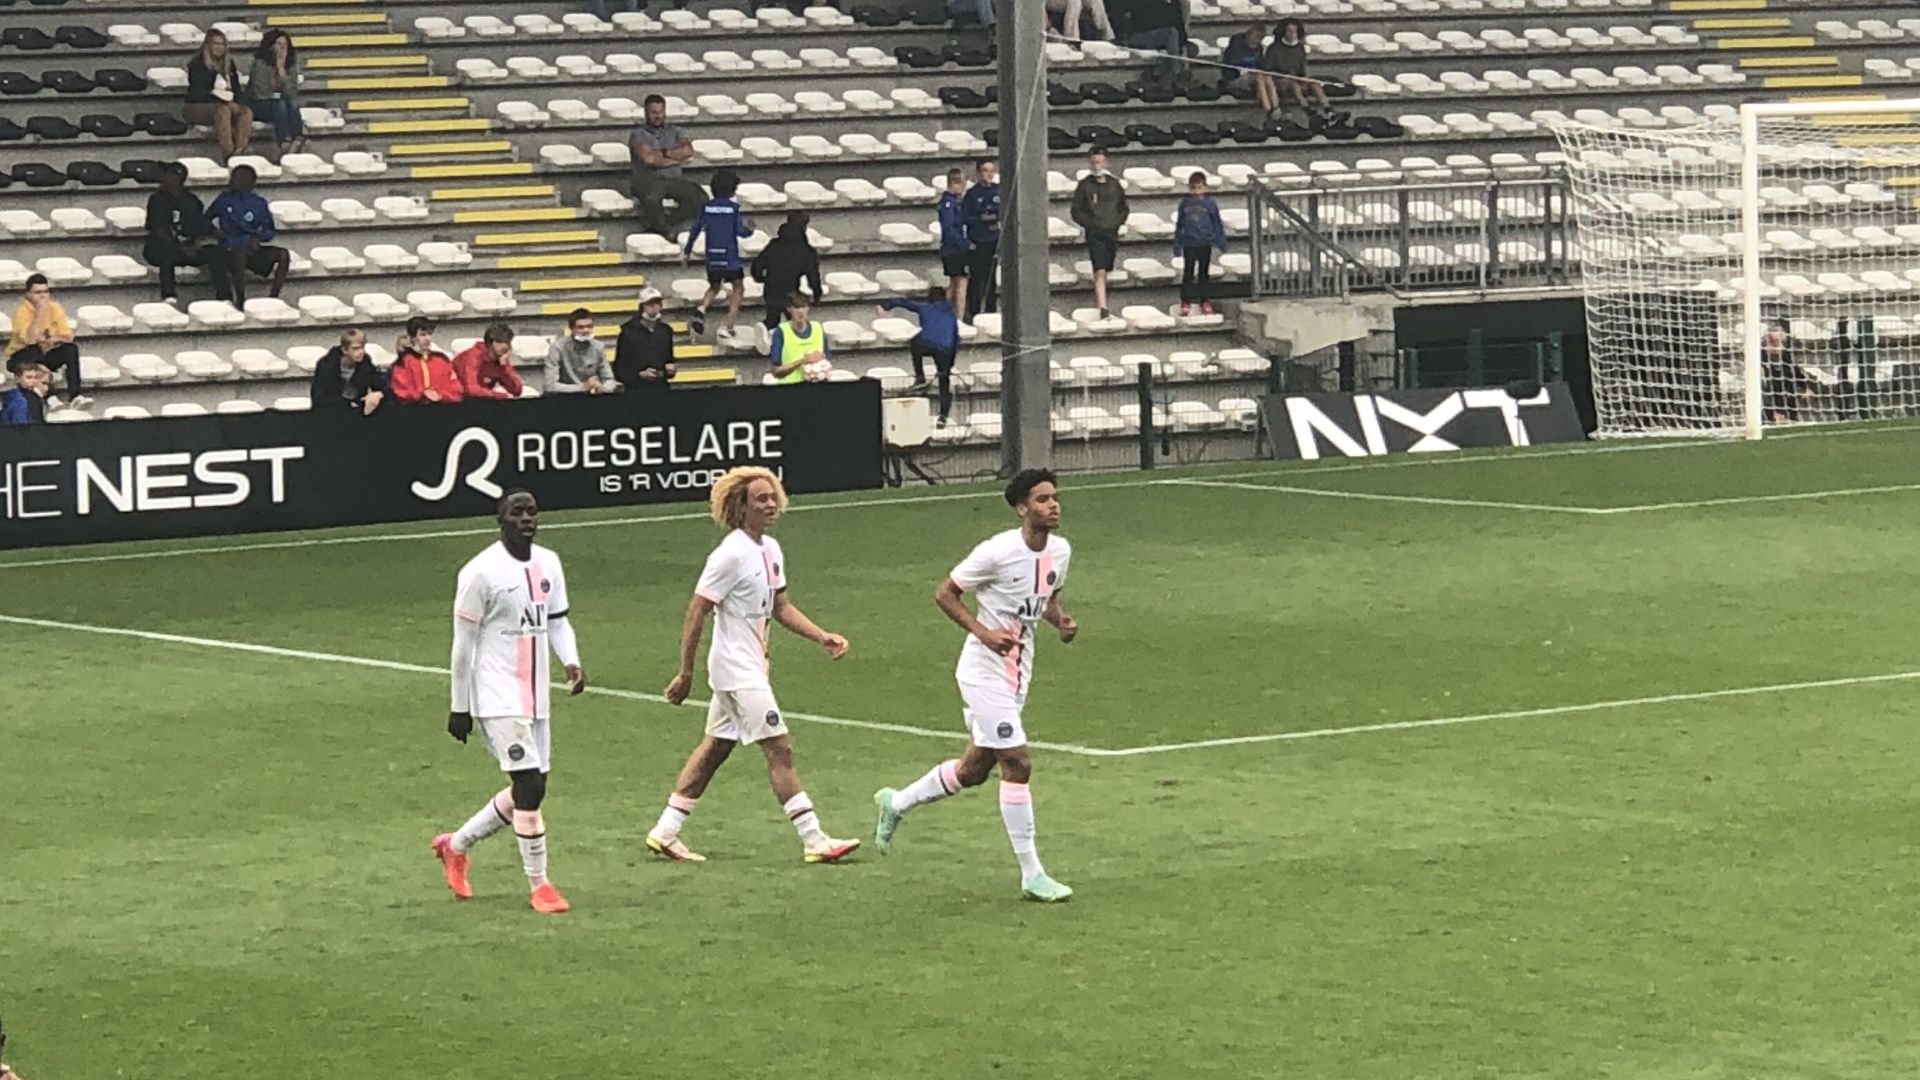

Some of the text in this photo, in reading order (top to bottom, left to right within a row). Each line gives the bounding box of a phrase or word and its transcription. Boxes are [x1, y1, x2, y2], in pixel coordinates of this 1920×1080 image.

[516, 419, 783, 472] ROESELARE
[1284, 387, 1550, 460] NXT
[76, 446, 305, 515] NEST
[600, 474, 622, 493] IS
